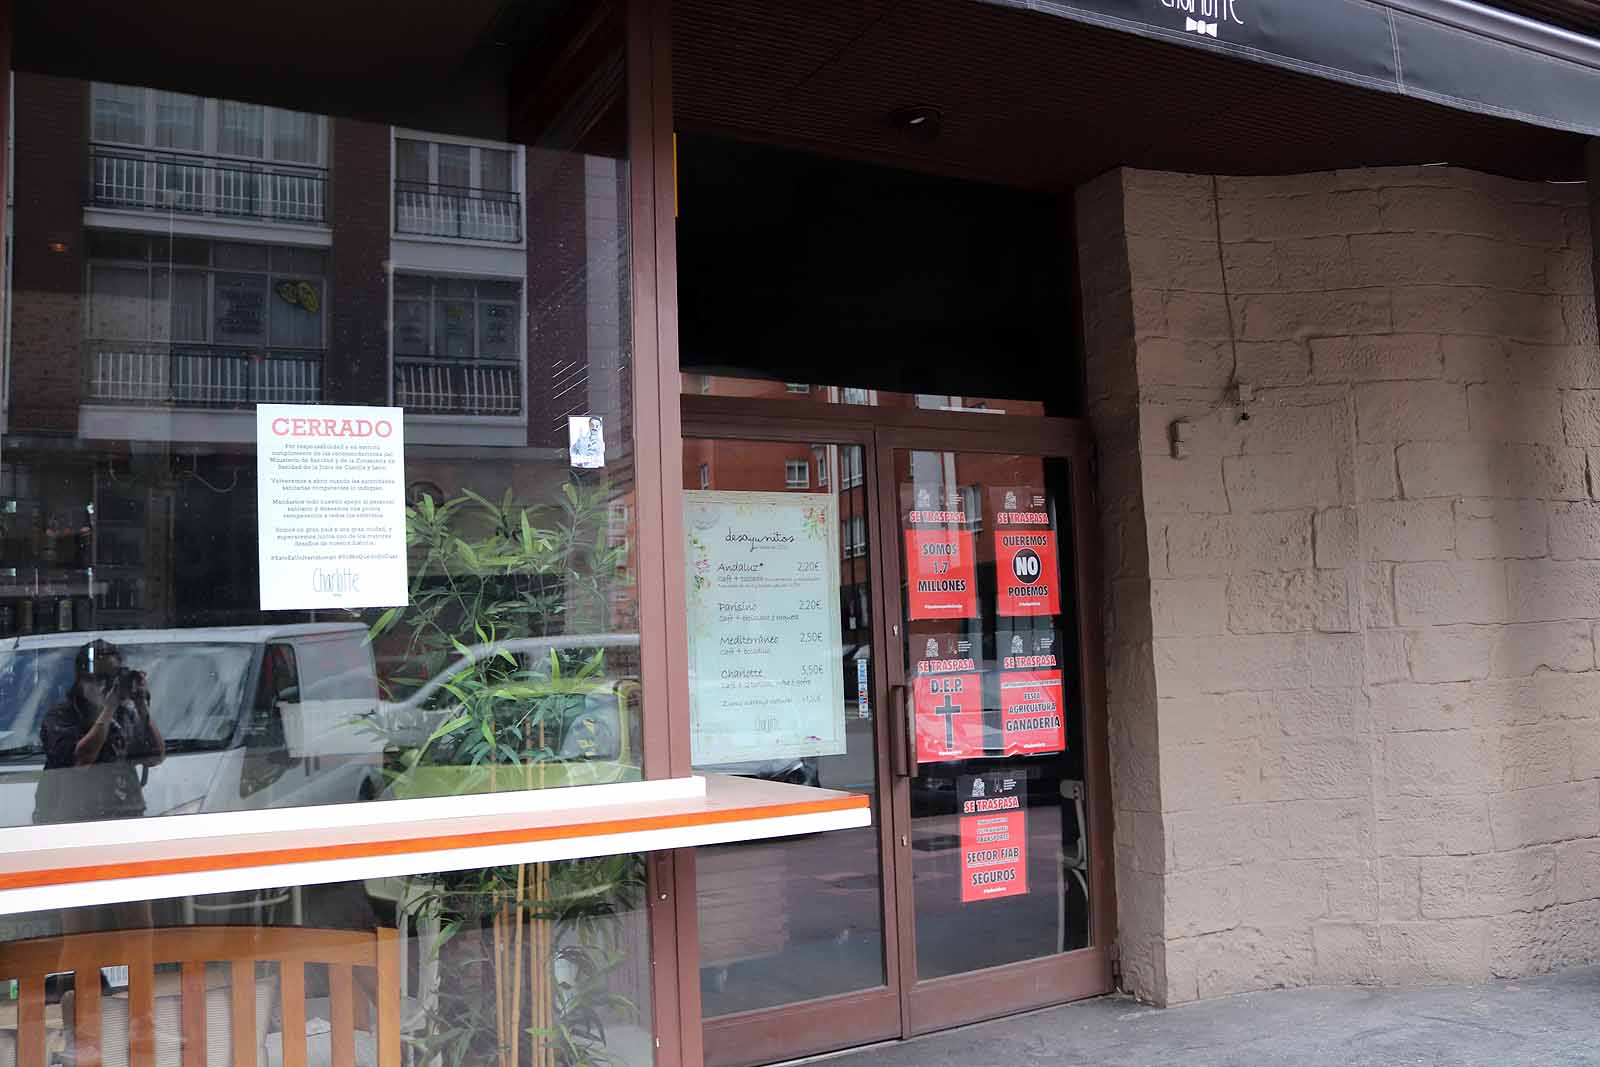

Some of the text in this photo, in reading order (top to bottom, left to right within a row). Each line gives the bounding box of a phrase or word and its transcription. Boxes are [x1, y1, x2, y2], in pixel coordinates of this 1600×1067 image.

[272, 418, 392, 438] CERRADO
[910, 511, 966, 522] SE TRASPASA
[997, 512, 1049, 524] SE TRASPASA
[725, 528, 796, 552] desayunitos
[1002, 536, 1047, 546] QUEREMOS
[923, 544, 957, 555] SOMOS
[933, 562, 949, 574] 1.7
[1015, 556, 1038, 576] NO
[312, 568, 360, 592] Charlotte
[918, 580, 966, 592] MILLONES
[1008, 586, 1048, 596] PODEMOS
[718, 602, 758, 612] Parisino
[918, 658, 975, 672] SE TRASPASA
[1004, 654, 1056, 668] SE TRASPASA
[931, 678, 963, 694] D.E.P.
[1008, 703, 1056, 714] AGRICULTURA
[964, 796, 1020, 814] SE TRASPASA
[967, 848, 1020, 864] SECTOR FIAB
[972, 868, 1016, 886] SEGUROS
